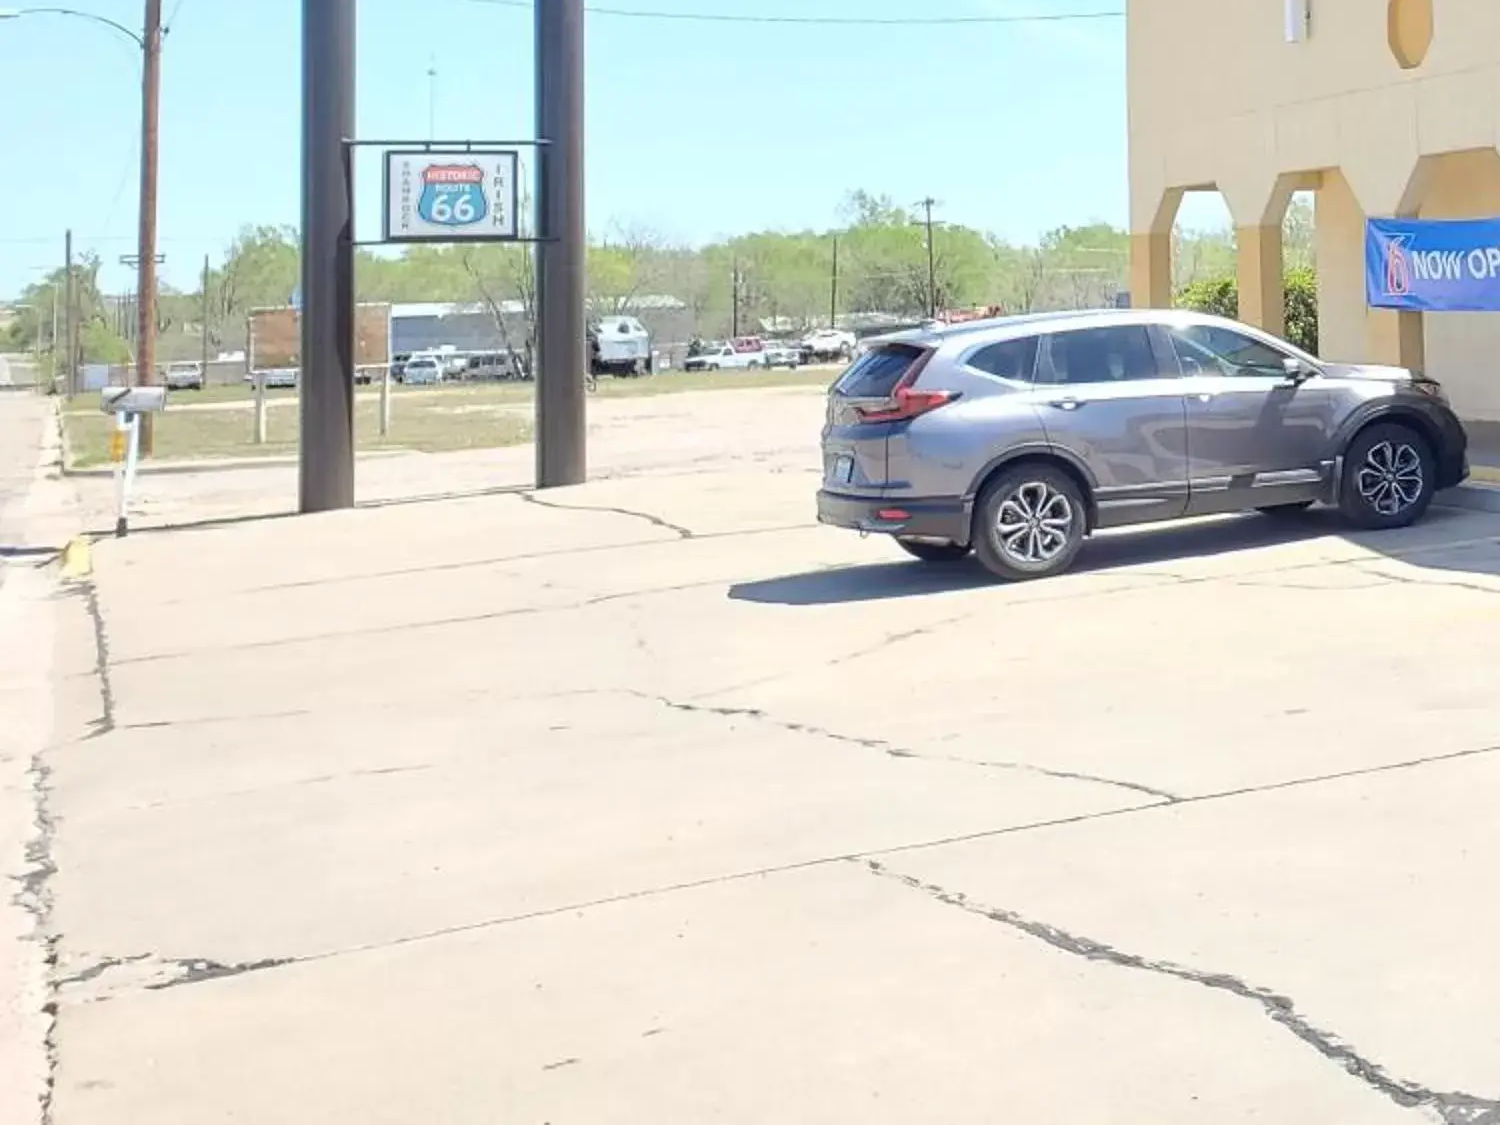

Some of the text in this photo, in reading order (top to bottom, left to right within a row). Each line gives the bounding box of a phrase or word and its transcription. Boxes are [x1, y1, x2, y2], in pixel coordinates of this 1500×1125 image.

[431, 194, 475, 222] 66
[492, 163, 505, 227] IRISH
[1411, 249, 1465, 280] NOW
